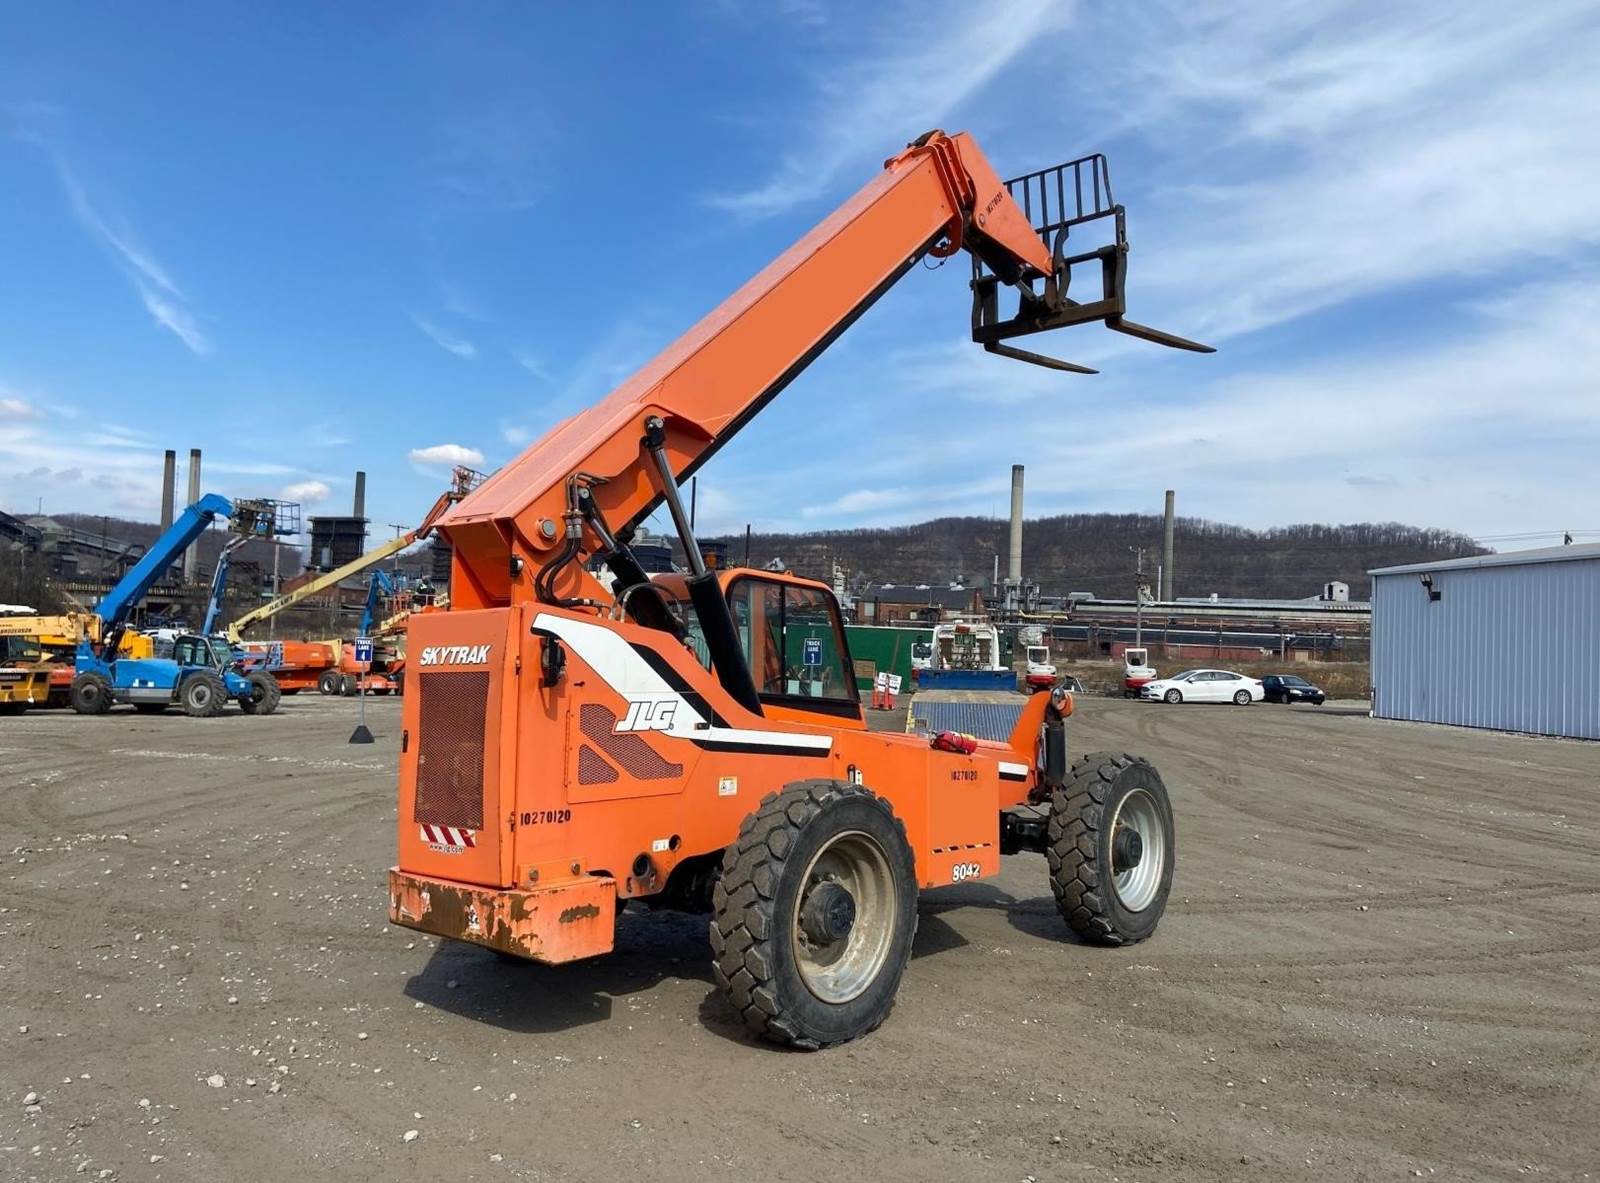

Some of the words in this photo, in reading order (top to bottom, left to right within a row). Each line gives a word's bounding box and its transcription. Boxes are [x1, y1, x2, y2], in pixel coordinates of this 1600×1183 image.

[420, 644, 491, 666] SKYTRAK
[614, 700, 679, 732] JLG
[520, 809, 571, 826] 10270120
[951, 862, 981, 882] 8042
